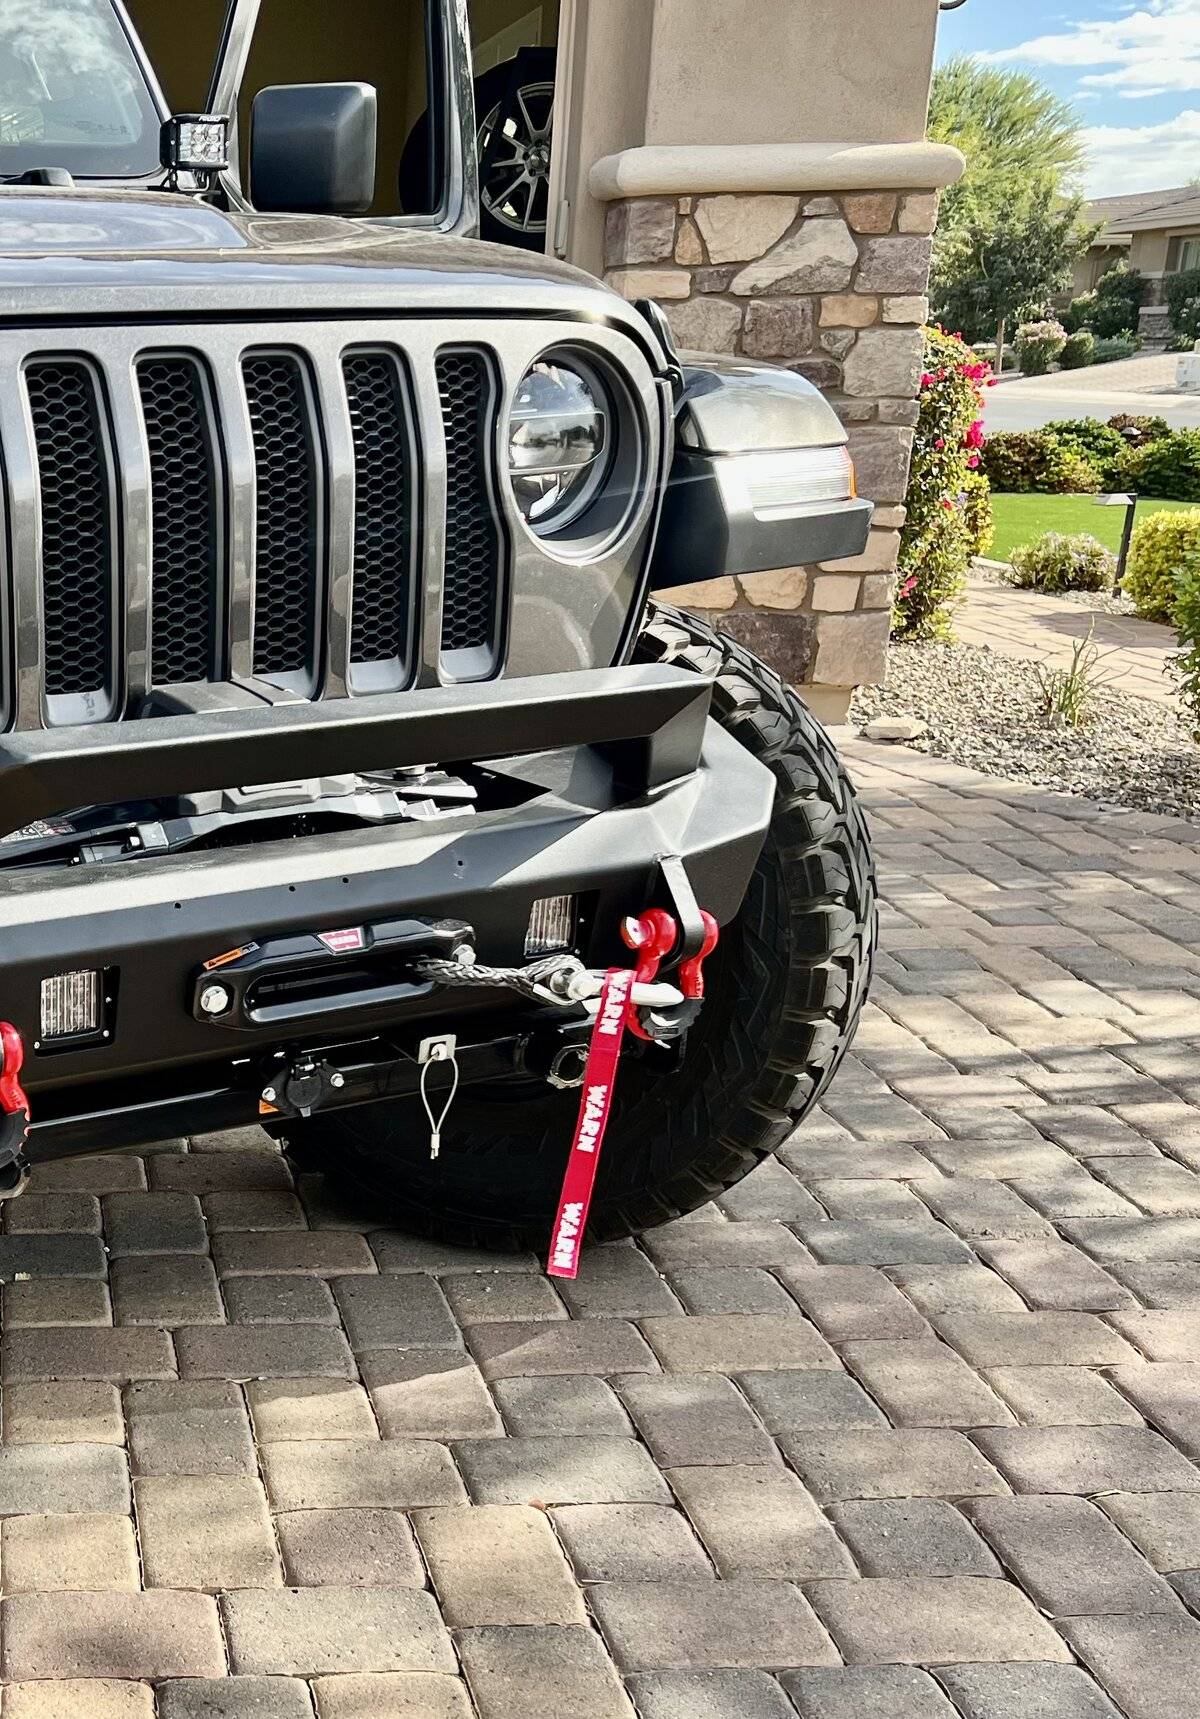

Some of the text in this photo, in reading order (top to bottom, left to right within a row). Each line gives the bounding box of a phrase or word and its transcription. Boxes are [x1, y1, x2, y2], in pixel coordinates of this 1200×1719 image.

[598, 970, 632, 1035] WARN
[576, 1084, 608, 1153] WARN
[553, 1202, 584, 1269] WARN
